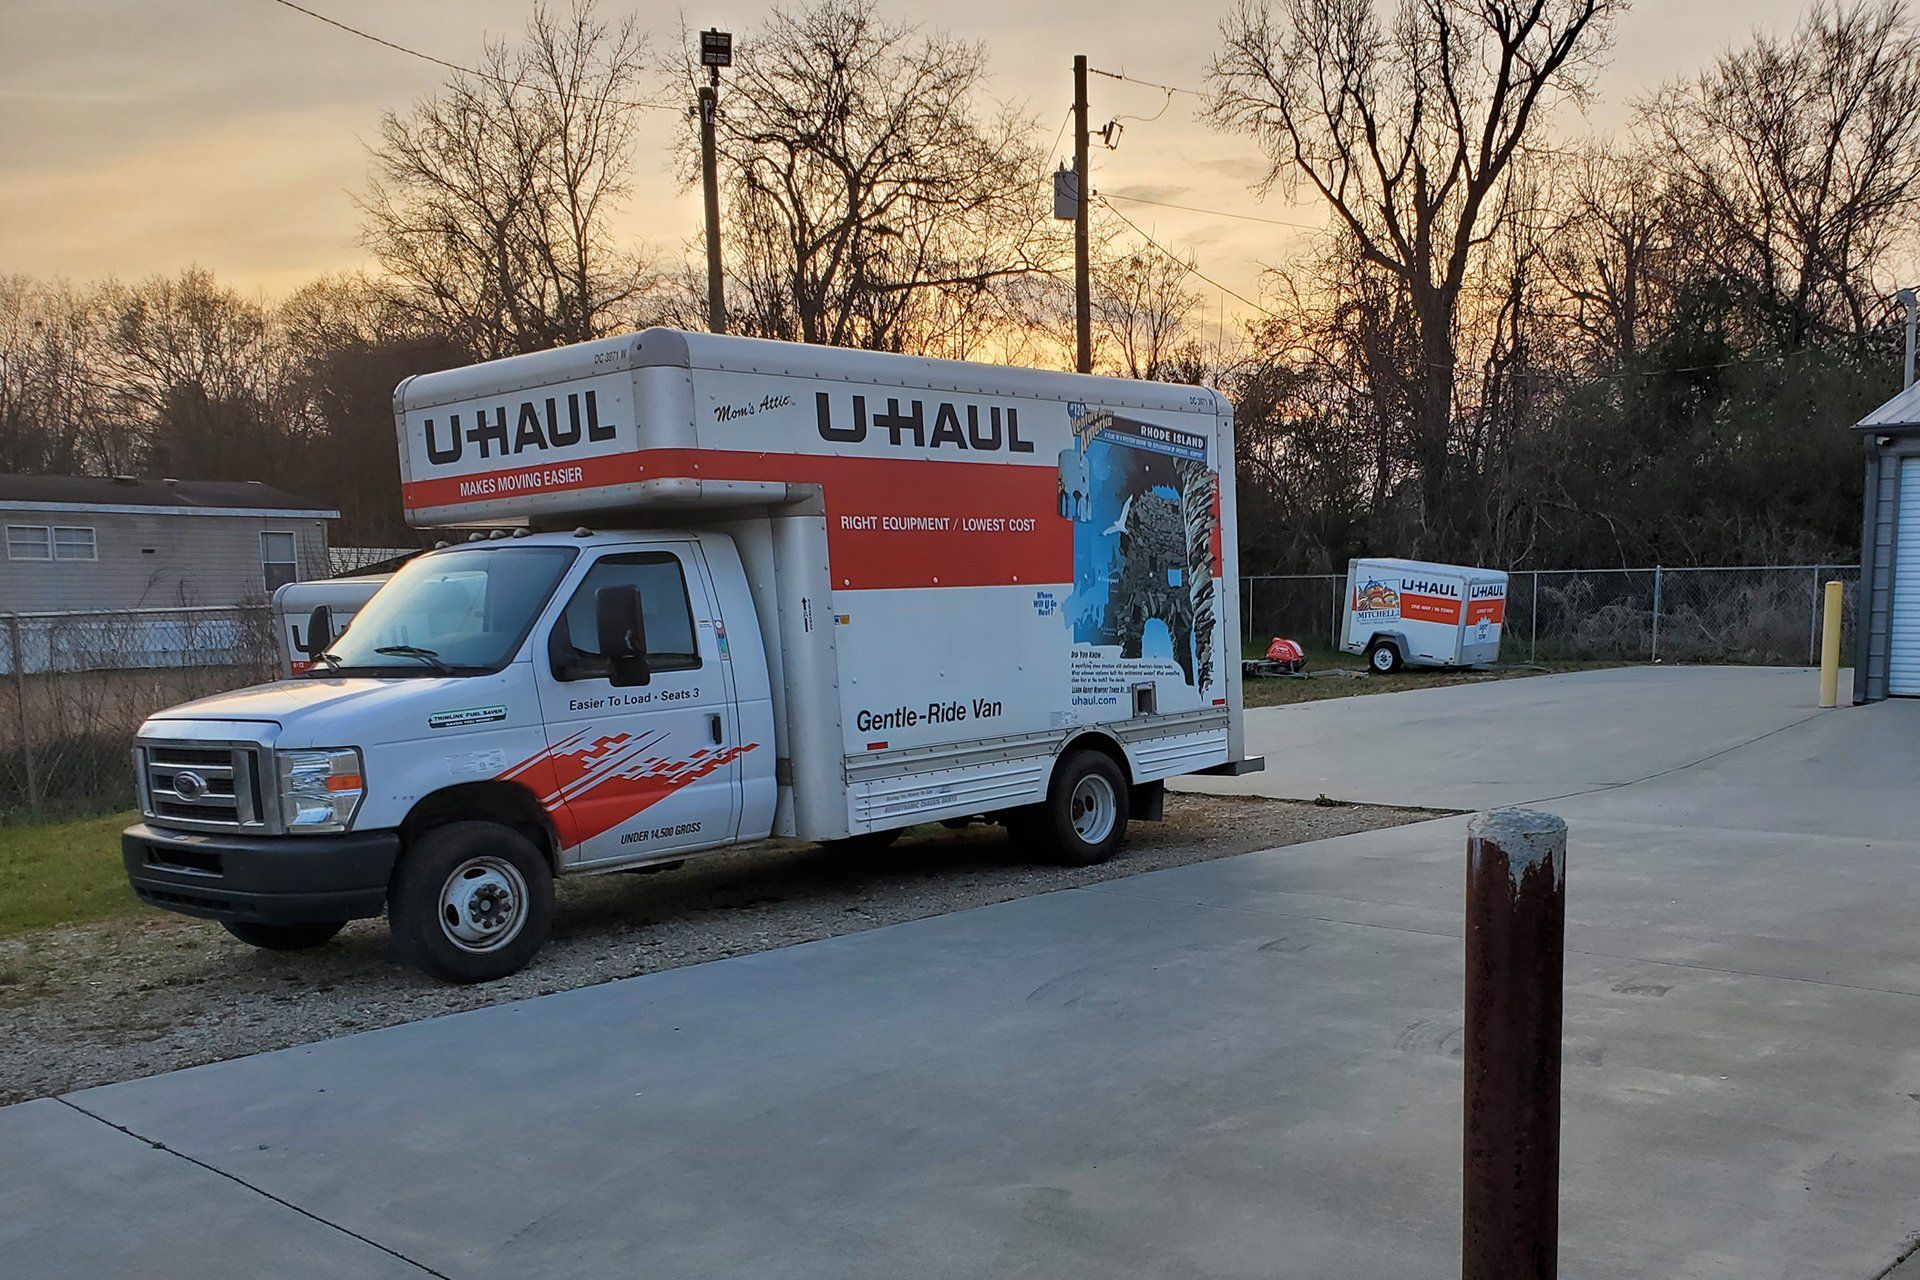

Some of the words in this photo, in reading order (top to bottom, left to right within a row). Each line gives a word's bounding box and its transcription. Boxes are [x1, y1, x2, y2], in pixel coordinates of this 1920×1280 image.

[714, 402, 755, 422] Mom's
[758, 394, 790, 414] Attic
[424, 390, 616, 466] U-HAUL
[815, 392, 1034, 453] U-HAUL
[1140, 425, 1170, 442] RHODE
[1173, 433, 1204, 448] ISLAND
[460, 478, 496, 497] MAKES
[498, 472, 542, 492] MOVING
[544, 466, 583, 486] EASIER
[840, 516, 878, 530] RIGHT
[882, 516, 950, 531] EQUIPMENT
[962, 518, 1006, 532] LOWEST
[1008, 518, 1036, 532] COST
[1402, 578, 1458, 596] U-HAUL
[1472, 584, 1504, 598] U-HAUL
[570, 698, 605, 710] Easier
[608, 696, 620, 706] To
[624, 692, 651, 705] Load
[660, 690, 690, 701] Seats
[693, 688, 700, 698] 3
[1072, 696, 1116, 706] uhaul.com
[857, 701, 966, 732] Gentle-Ride
[972, 698, 1002, 718] Van
[620, 830, 650, 844] UNDER
[650, 827, 674, 840] 14,500
[674, 822, 702, 836] GROSS
